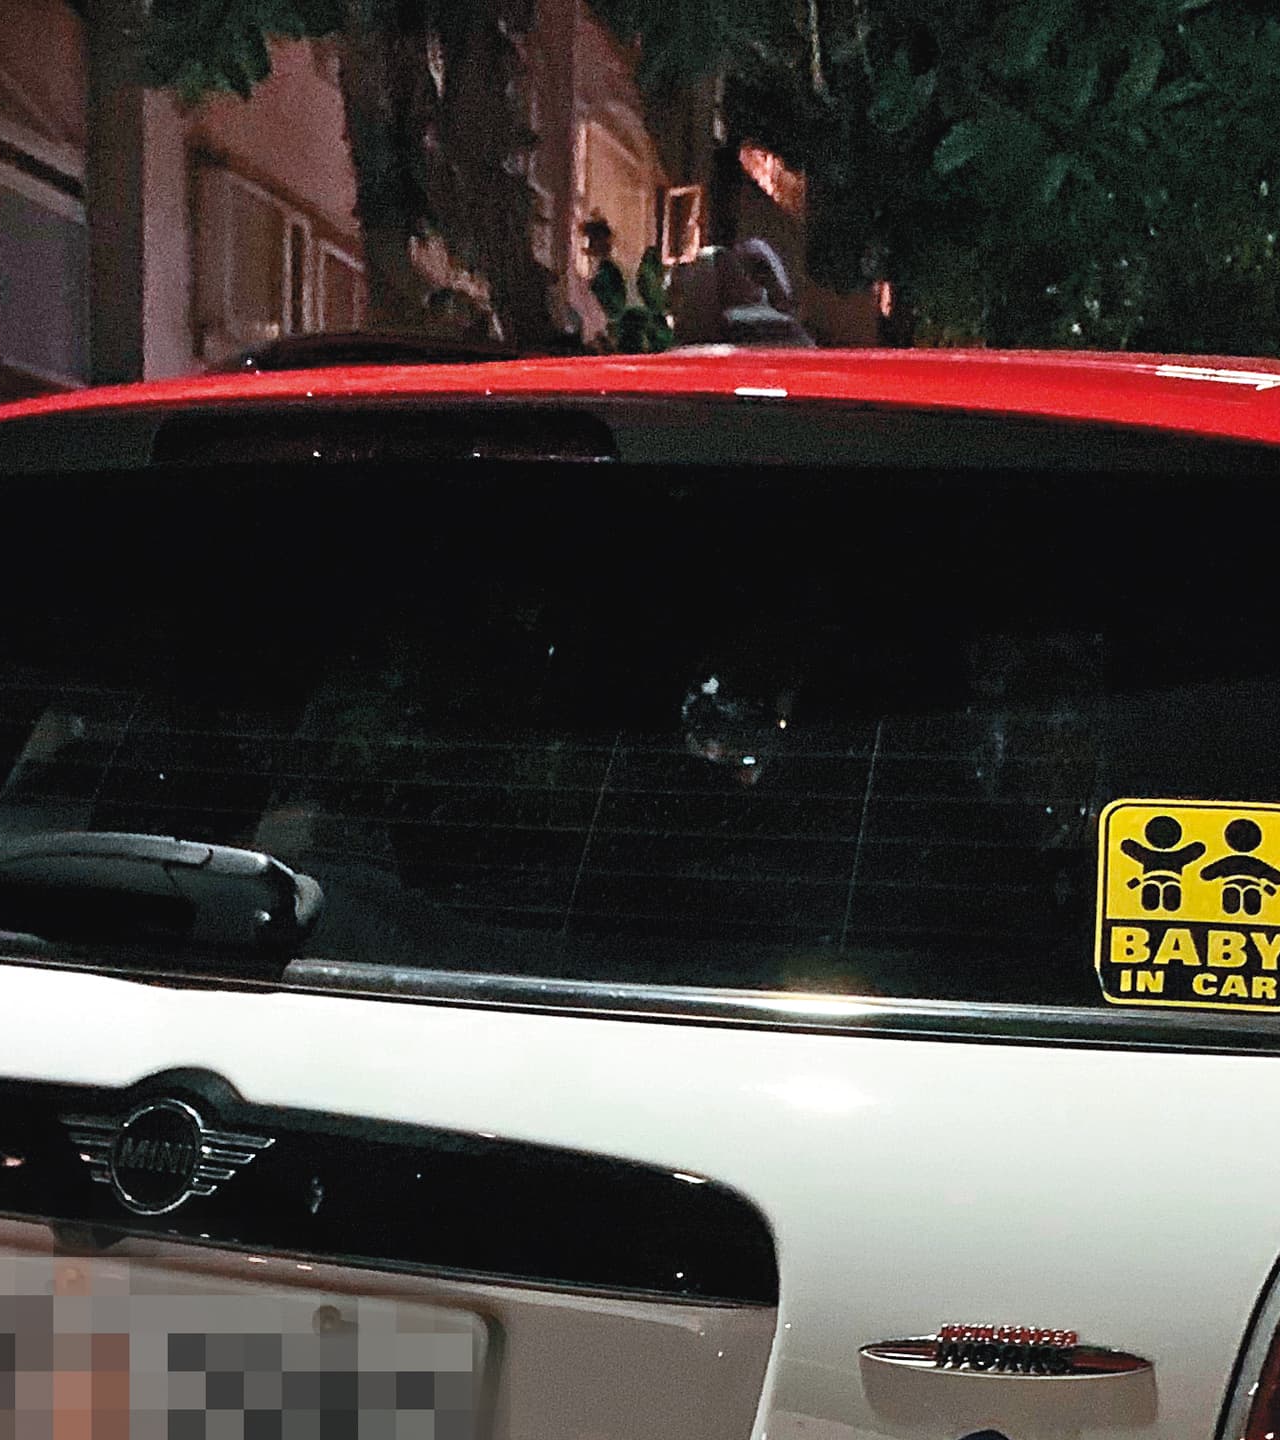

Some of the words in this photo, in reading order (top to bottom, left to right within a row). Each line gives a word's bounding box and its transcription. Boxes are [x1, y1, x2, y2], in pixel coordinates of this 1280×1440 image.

[1119, 969, 1165, 993] IN
[1192, 972, 1278, 999] CAR
[117, 1136, 194, 1176] MINI
